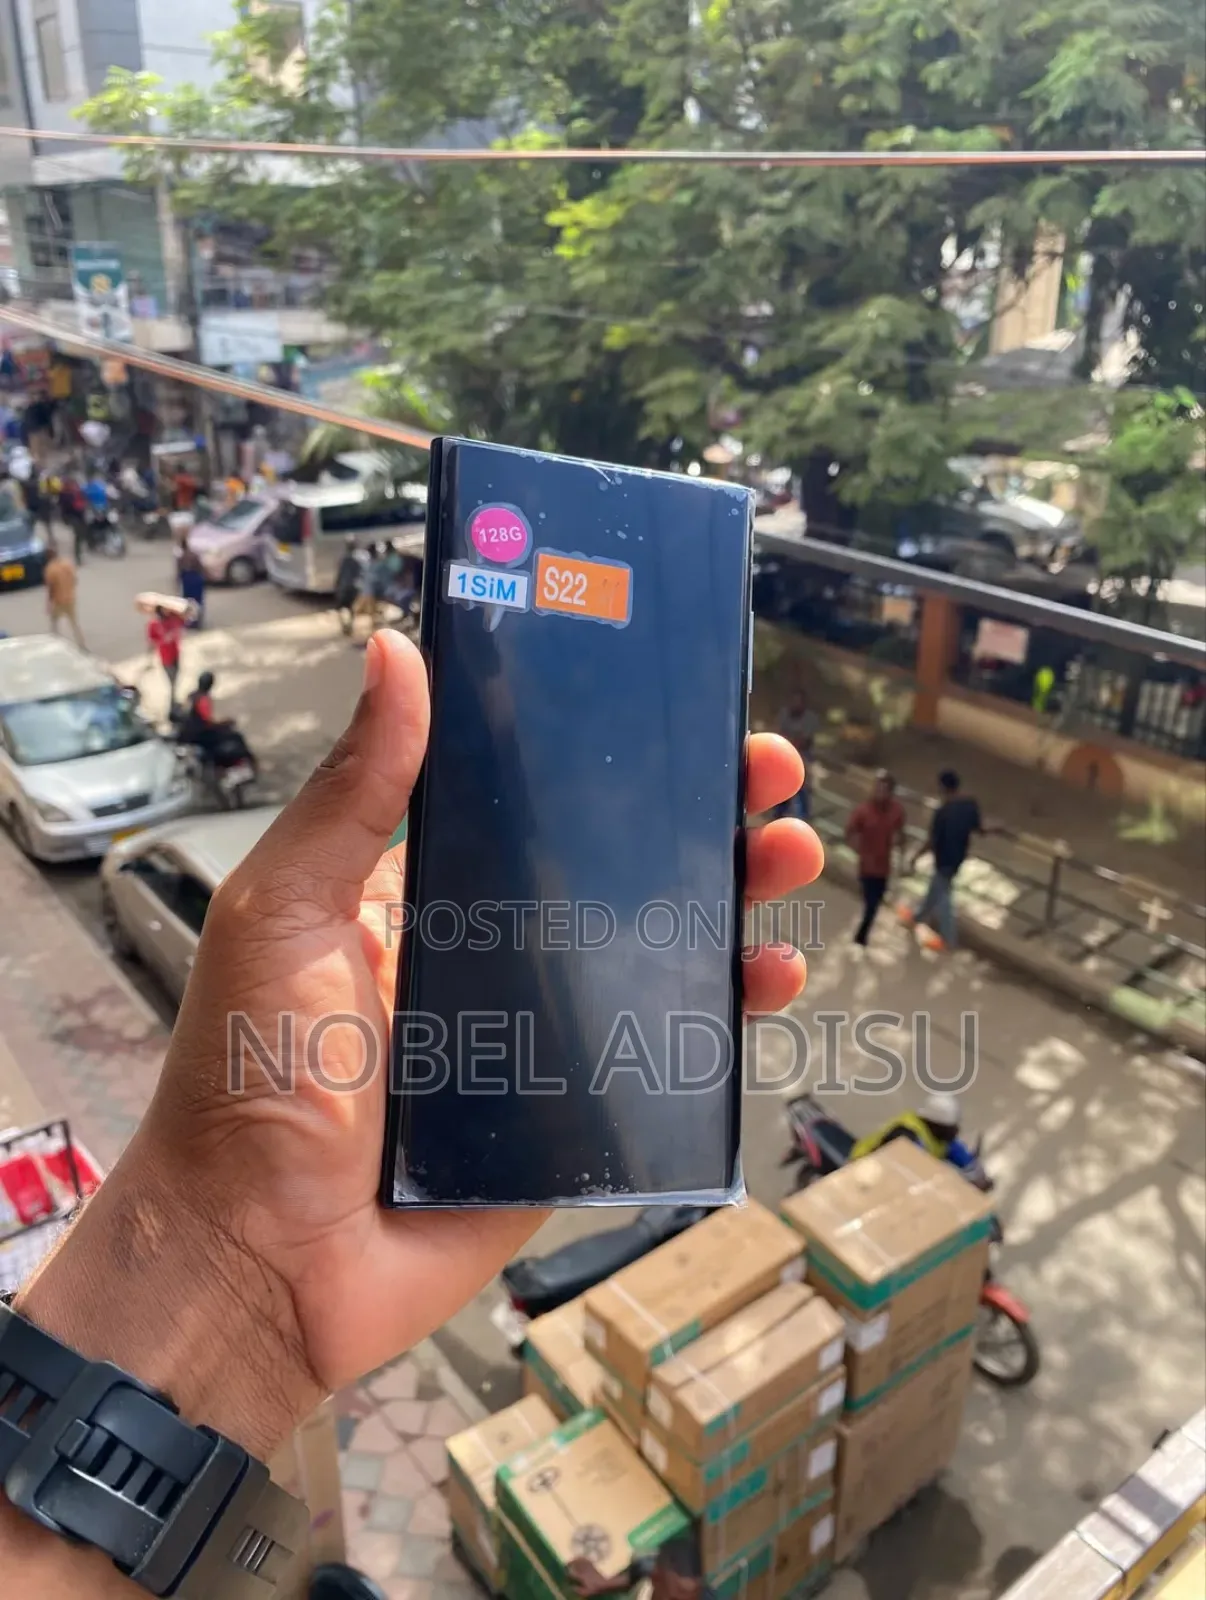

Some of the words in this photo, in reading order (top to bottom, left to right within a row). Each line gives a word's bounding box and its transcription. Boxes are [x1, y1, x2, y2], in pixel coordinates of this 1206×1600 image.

[479, 526, 522, 543] 128G
[457, 573, 516, 601] 1SiM
[543, 566, 587, 605] S22
